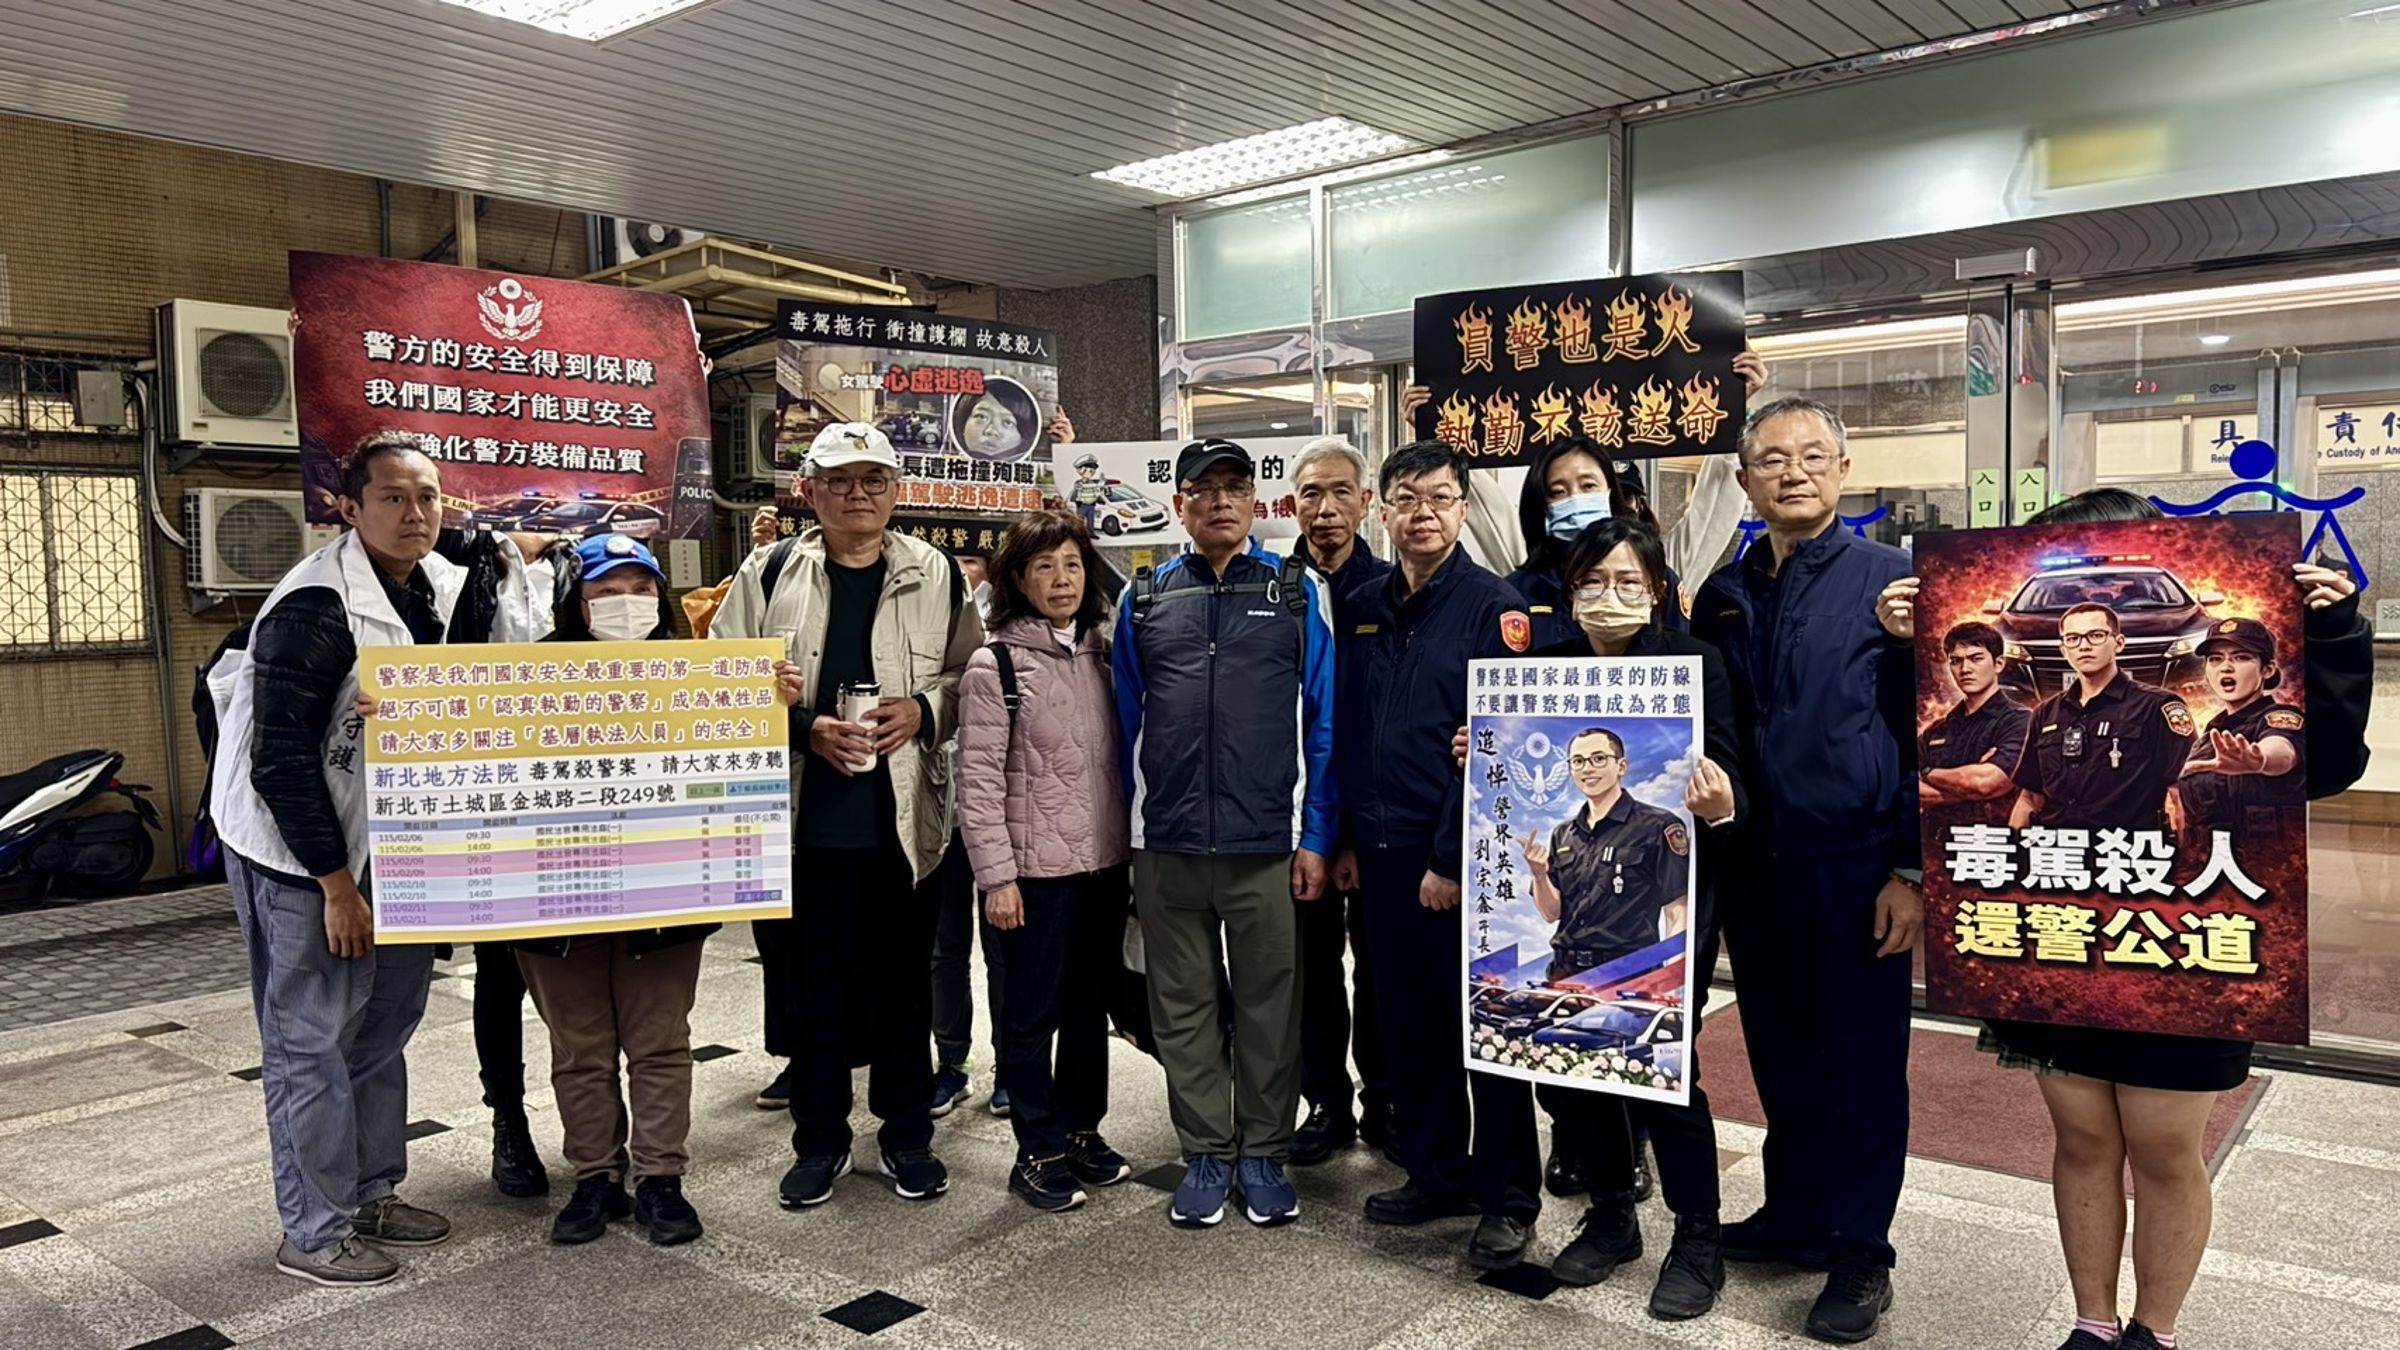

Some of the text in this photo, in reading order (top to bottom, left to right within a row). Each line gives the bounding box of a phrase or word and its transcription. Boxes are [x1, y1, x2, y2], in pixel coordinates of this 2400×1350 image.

[789, 310, 877, 339] 毒駕拖行
[976, 328, 1049, 358] 故意殺人
[1457, 306, 1701, 375] 員警也是人
[363, 330, 656, 387] 警方的安全得到保障
[364, 379, 655, 429] 我們國家才能更安全
[1435, 394, 1729, 457] 執勤不該送命
[412, 431, 645, 474] 強化警方裝備品質
[2326, 446, 2365, 459] Custody
[2370, 446, 2380, 457] of
[1976, 472, 1995, 513] 入口
[2020, 472, 2040, 513] 入口
[378, 656, 773, 688] 警察是我們國家安全最重要的第一道防線
[1476, 665, 1691, 687] 警察是國家最重要的防線
[1475, 693, 1692, 714] 不要讓警察殉職成為常態
[374, 763, 519, 789] 新北地方法院
[374, 784, 676, 817] 新北市土城區金城路二段249號
[466, 831, 491, 840] 09:30
[467, 843, 491, 851] 14:00
[467, 855, 492, 864] 09:30
[468, 867, 492, 875] 14:00
[1945, 824, 2266, 901] 毒駕殺人
[468, 878, 493, 887] 09:30
[469, 890, 493, 899] 14:00
[469, 902, 494, 911] 09:30
[470, 914, 494, 923] 14:00
[1954, 899, 2259, 975] 還警公道
